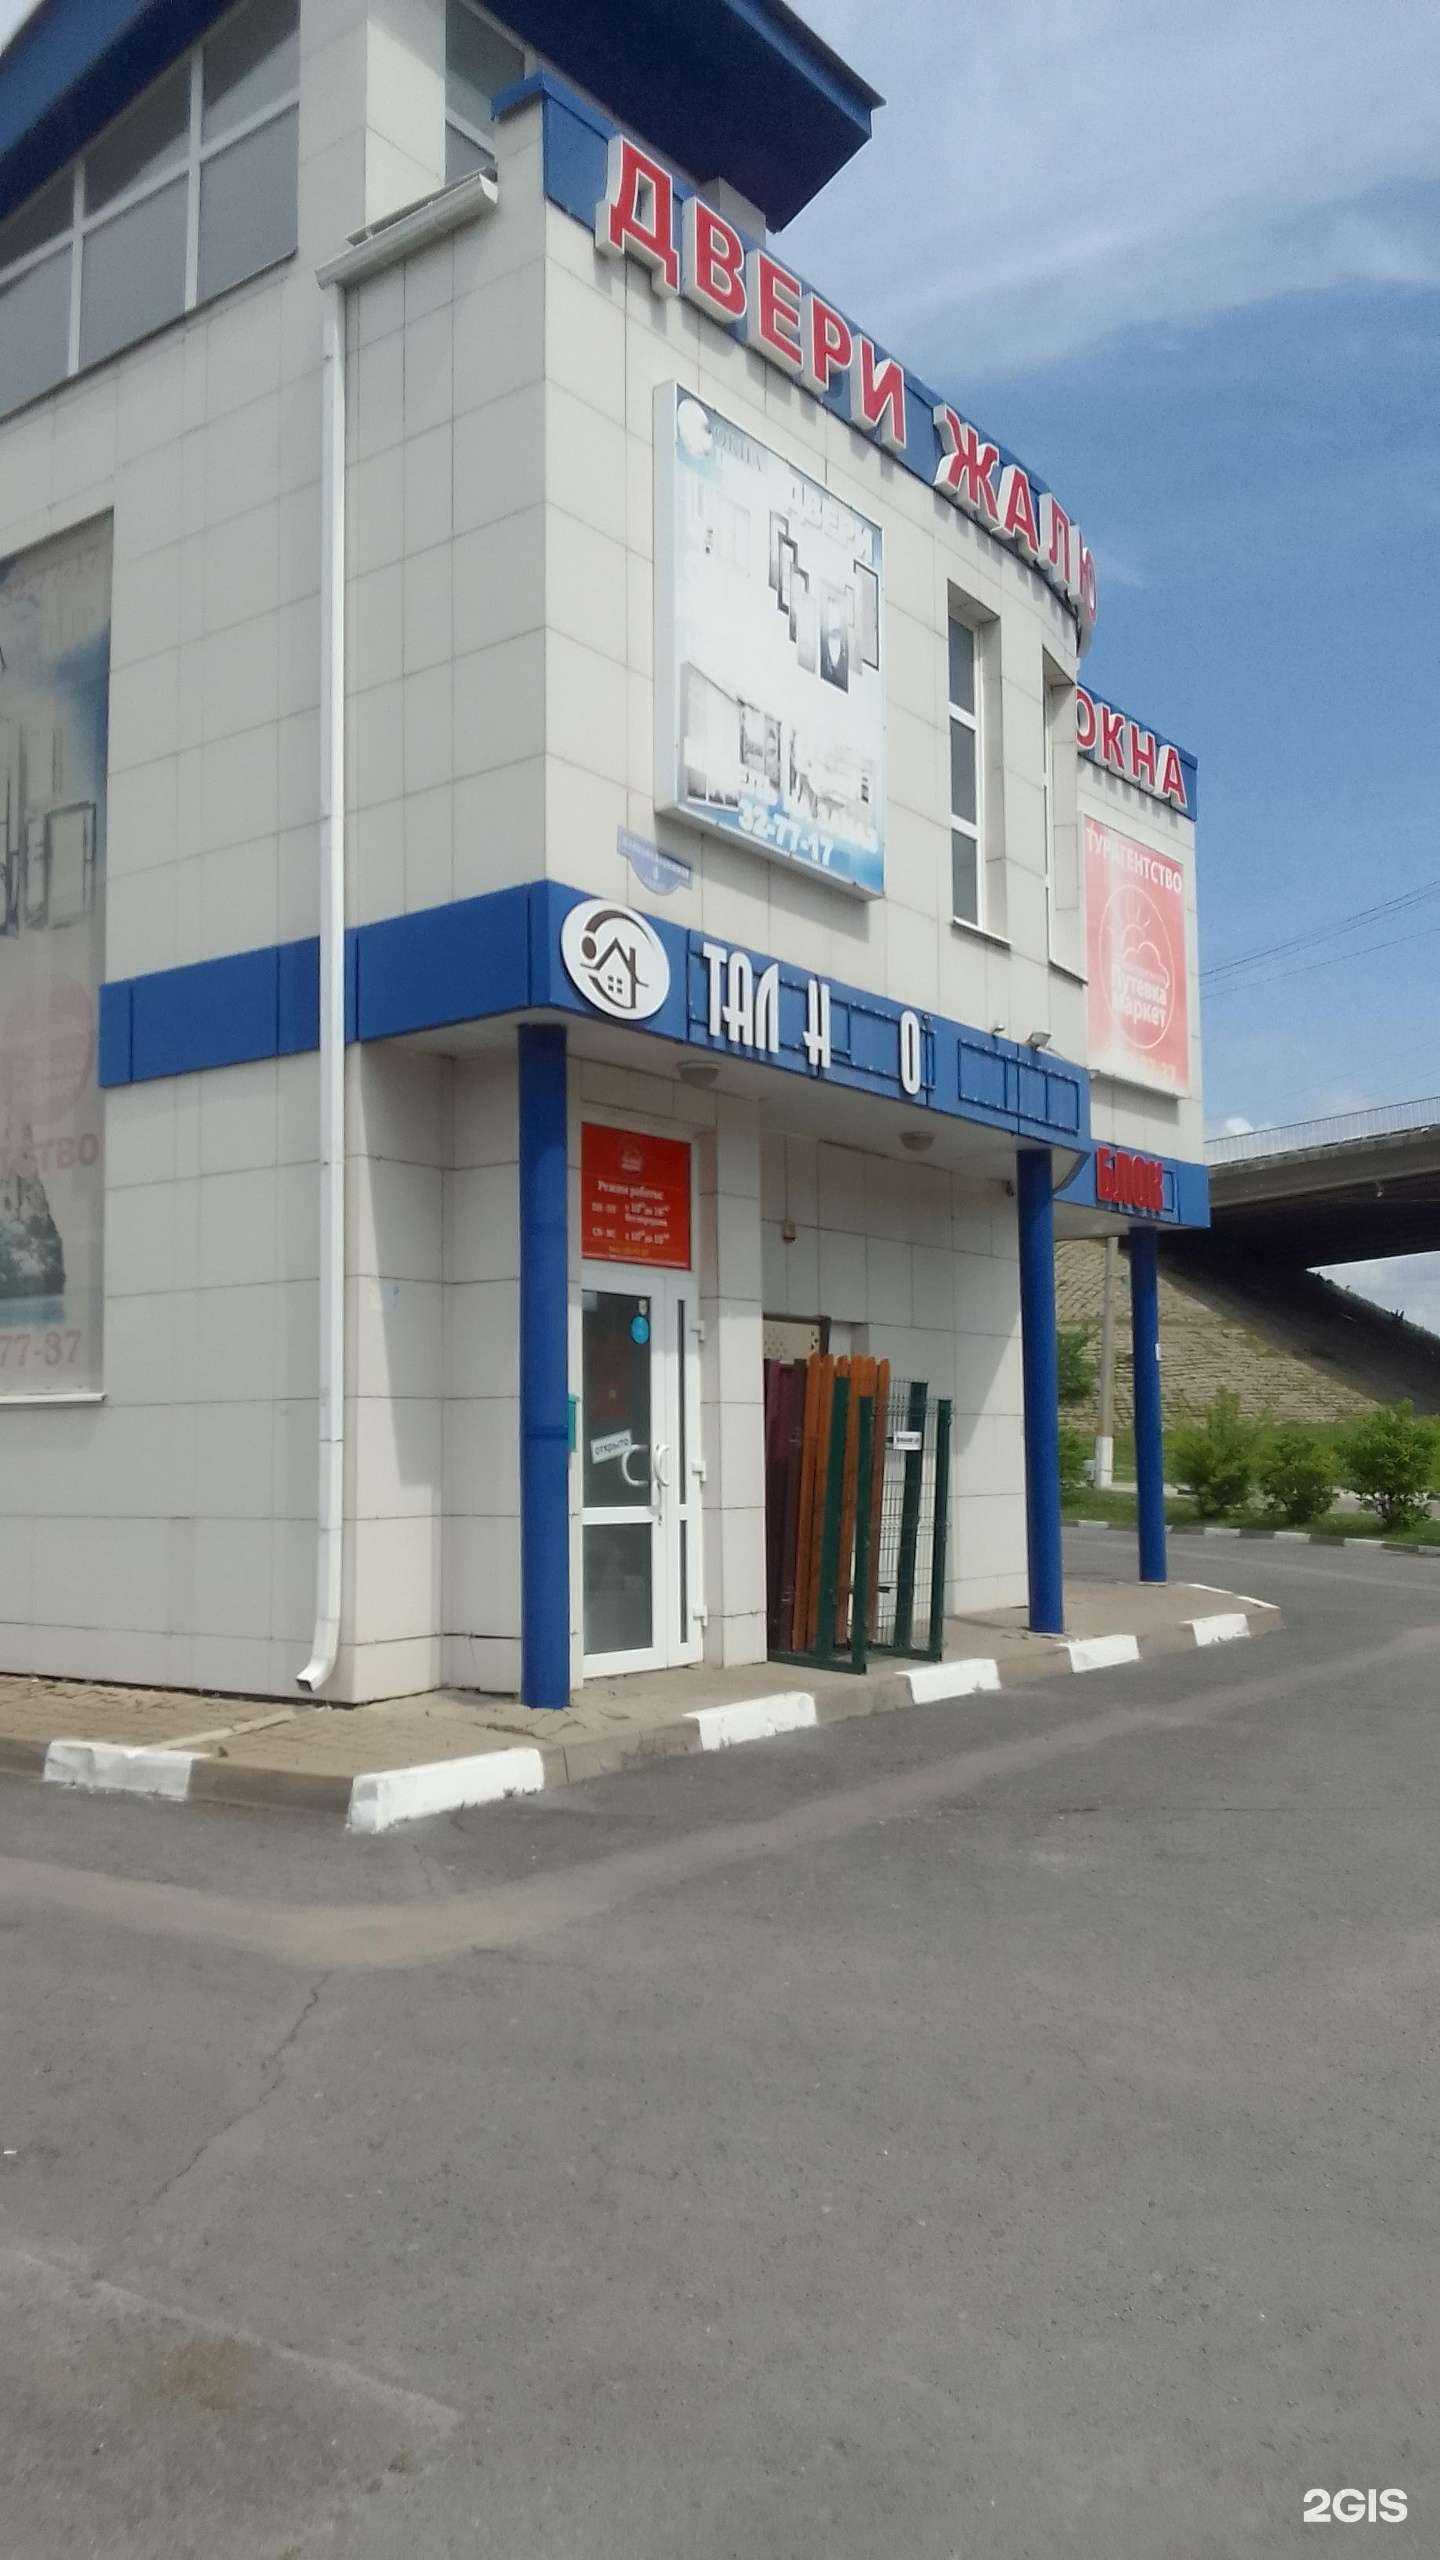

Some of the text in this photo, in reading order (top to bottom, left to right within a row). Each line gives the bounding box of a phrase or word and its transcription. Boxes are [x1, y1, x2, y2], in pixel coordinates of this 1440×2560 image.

[598, 135, 907, 449] ДВЕРИ
[1077, 688, 1188, 807] ОКНА
[703, 942, 779, 1054] ТАЛ
